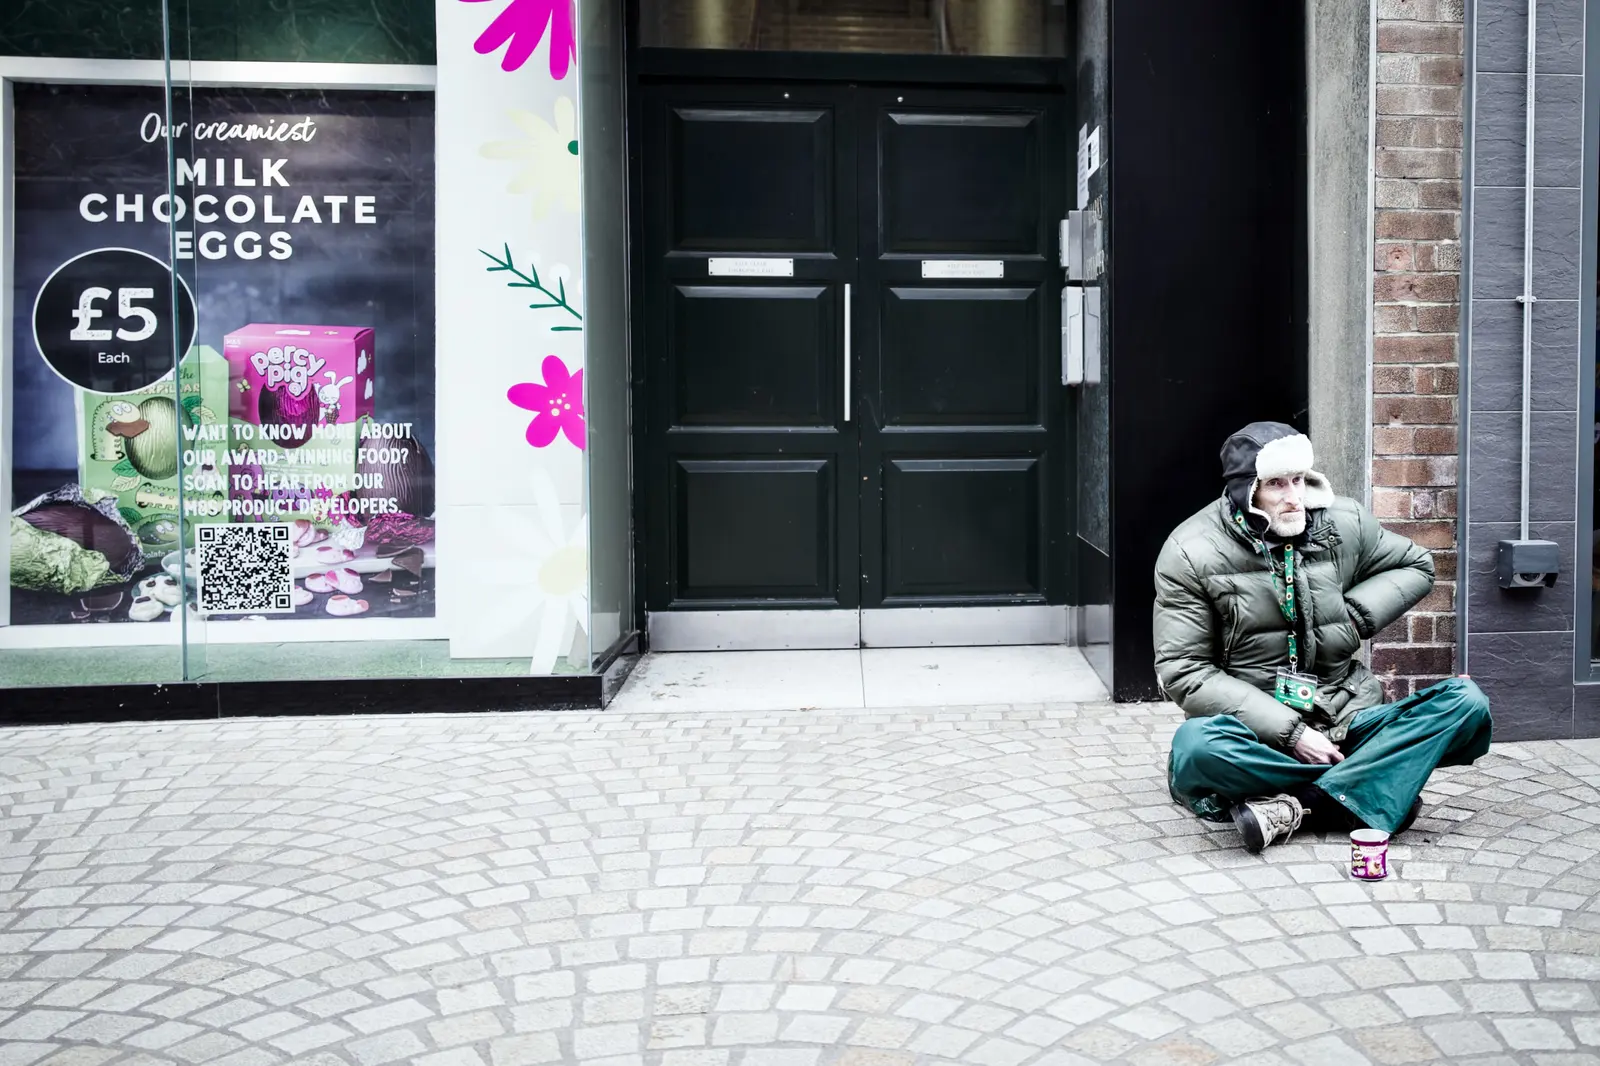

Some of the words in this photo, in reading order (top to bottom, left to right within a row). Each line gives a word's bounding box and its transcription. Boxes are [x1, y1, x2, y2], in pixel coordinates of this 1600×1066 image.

[140, 112, 187, 144] Our
[194, 115, 318, 143] creamiest
[176, 158, 290, 187] MILK
[79, 193, 377, 224] CHOCOLATE
[175, 231, 293, 260] EGGS
[70, 286, 158, 342] £5
[98, 352, 130, 363] Each
[250, 345, 326, 377] percy
[267, 362, 308, 396] pig
[182, 424, 228, 440] WANT
[232, 424, 254, 440] TO
[259, 424, 307, 440] KNOW
[311, 423, 355, 439] MORE
[360, 423, 412, 439] ABOUT
[183, 450, 216, 466] OUR
[358, 448, 409, 464] FOOD?
[184, 474, 228, 490] SCAN
[232, 474, 253, 490] TO
[258, 474, 300, 490] HEAR
[304, 473, 347, 489] FROM
[352, 473, 384, 489] OUR
[222, 499, 295, 516] PRODUCT
[299, 497, 402, 515] DEVELOPERS.
